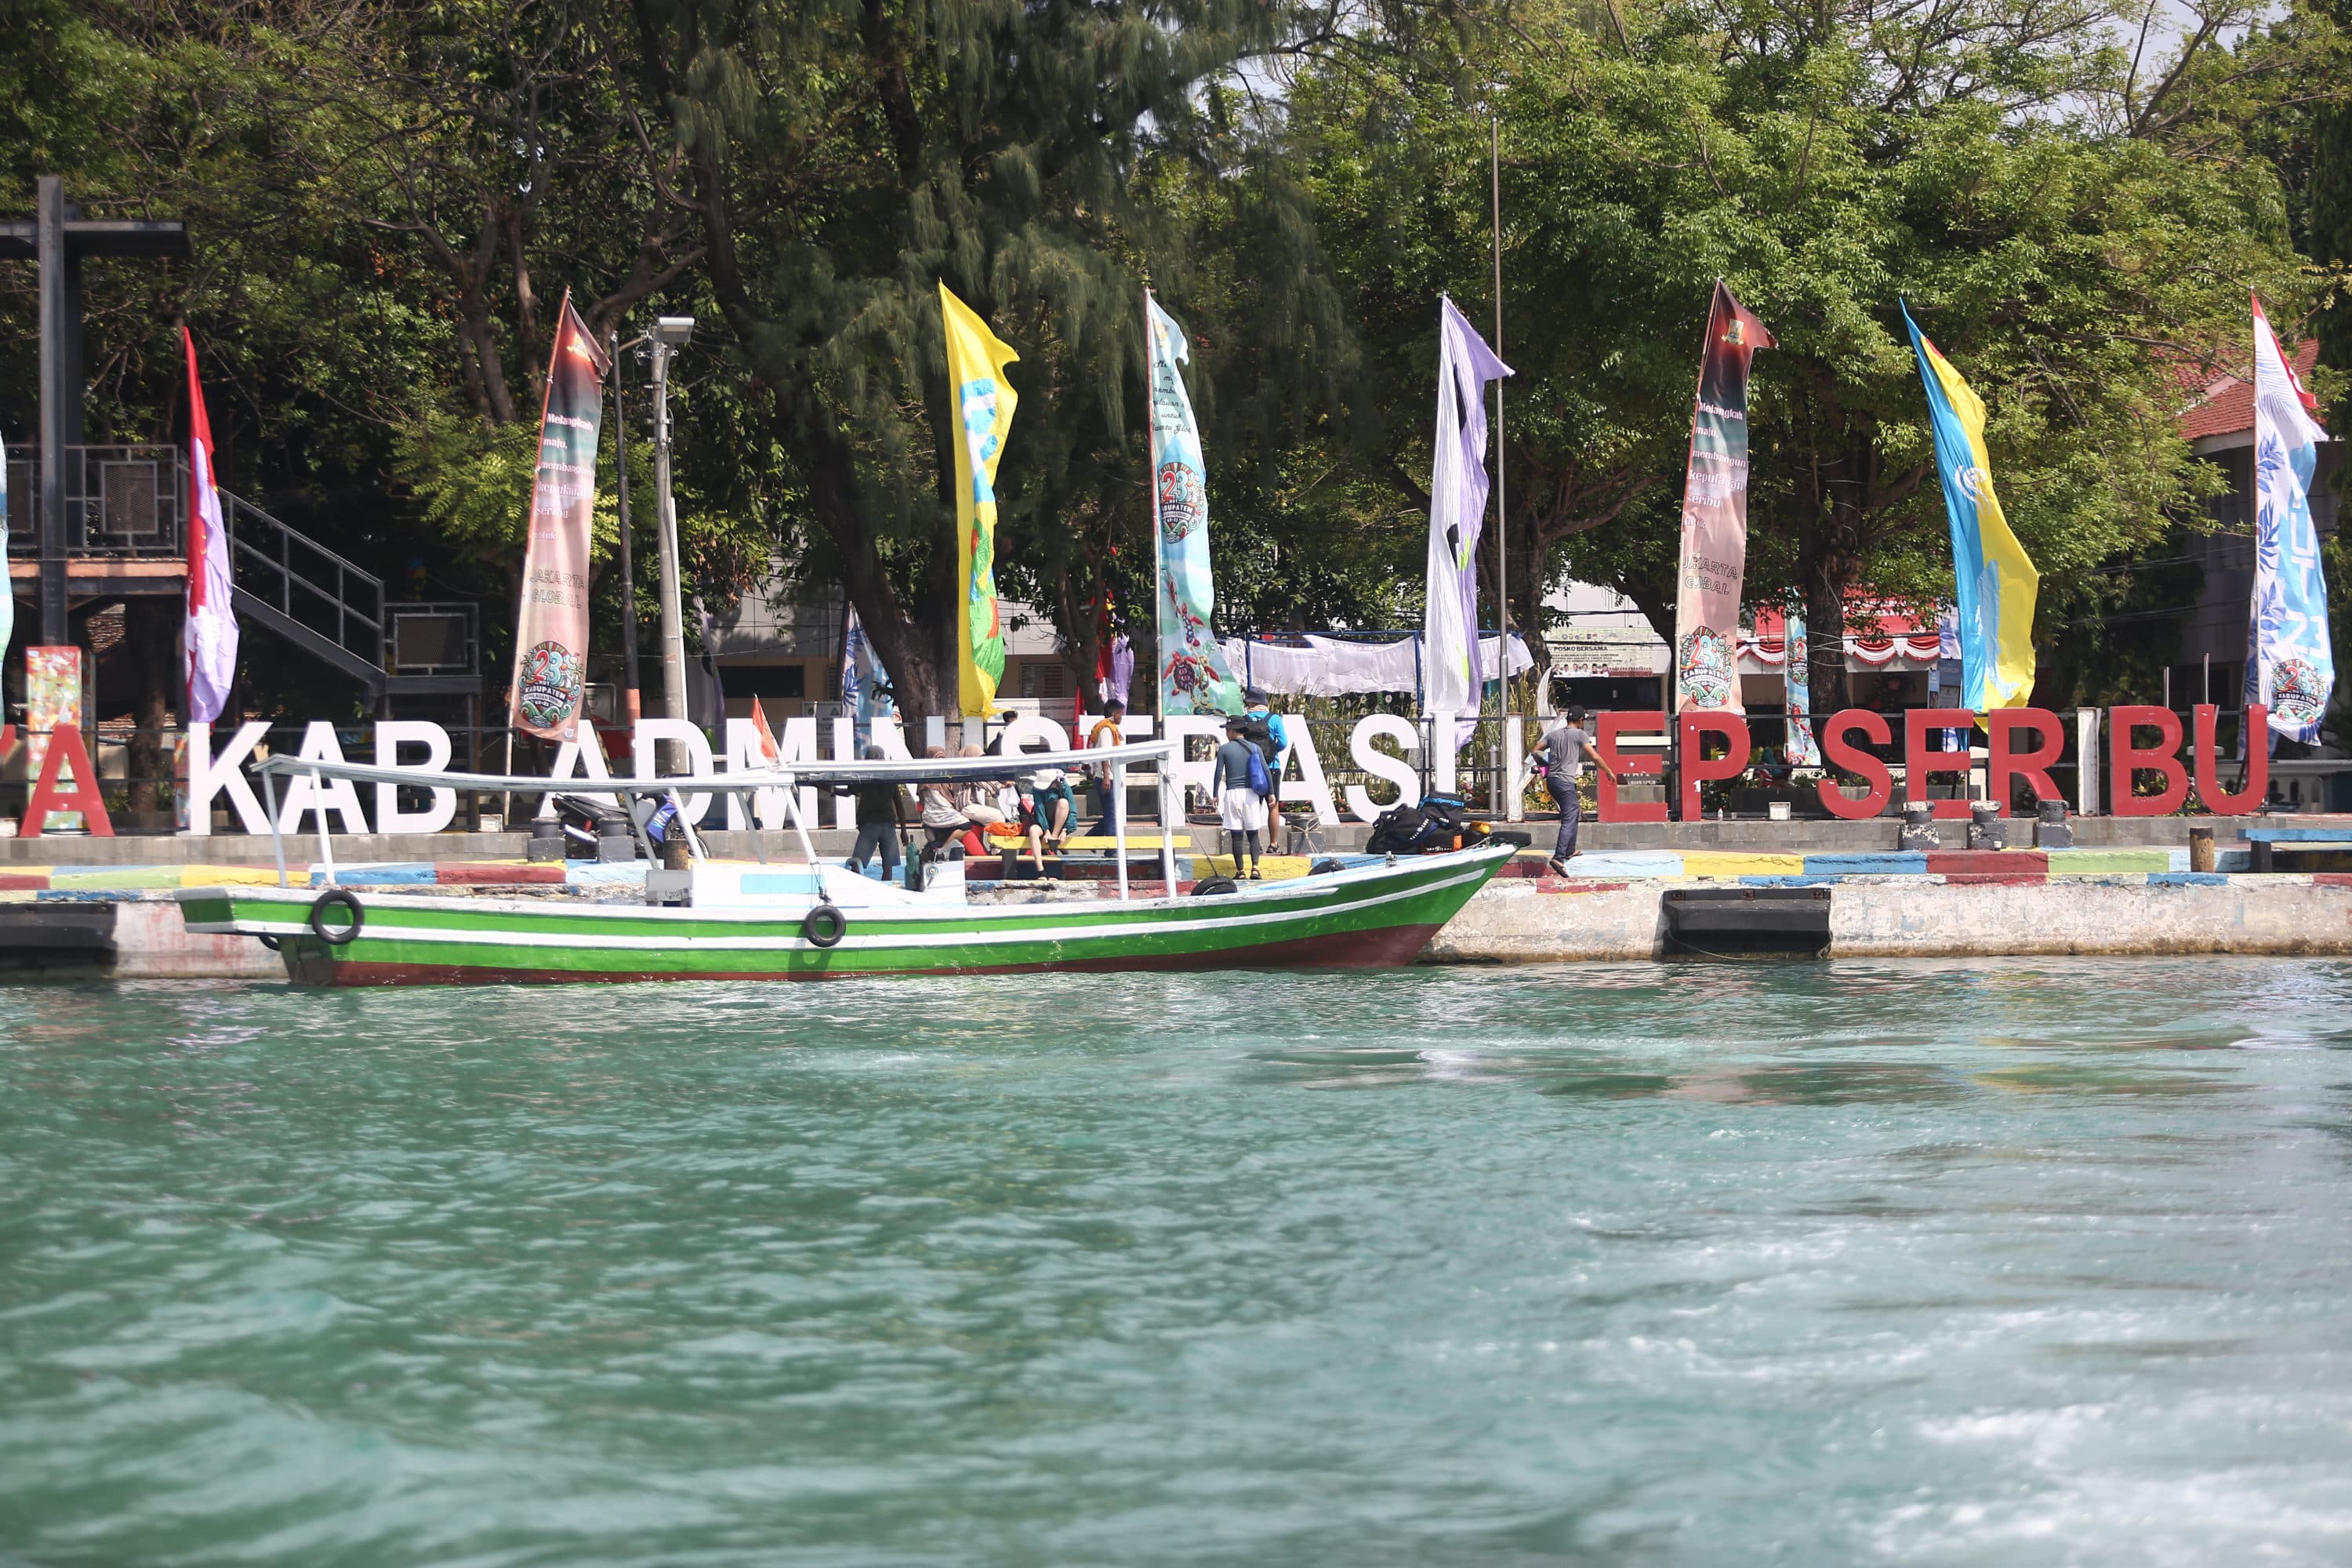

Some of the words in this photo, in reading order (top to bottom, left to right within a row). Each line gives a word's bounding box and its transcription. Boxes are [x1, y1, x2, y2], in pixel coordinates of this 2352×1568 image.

[1699, 402, 1744, 421] Melangkah
[1695, 426, 1719, 438] maju,
[1692, 450, 1747, 468] membangun
[1162, 470, 1188, 501] 23
[1688, 470, 1744, 491] kepulauan
[1686, 494, 1721, 510] seribu
[532, 588, 582, 609] GLOBAL
[535, 649, 563, 685] 23
[2285, 666, 2310, 695] 23
[524, 685, 567, 699] KABUPATEN
[188, 720, 457, 836] KAB
[1817, 704, 2269, 819] SERIBU
